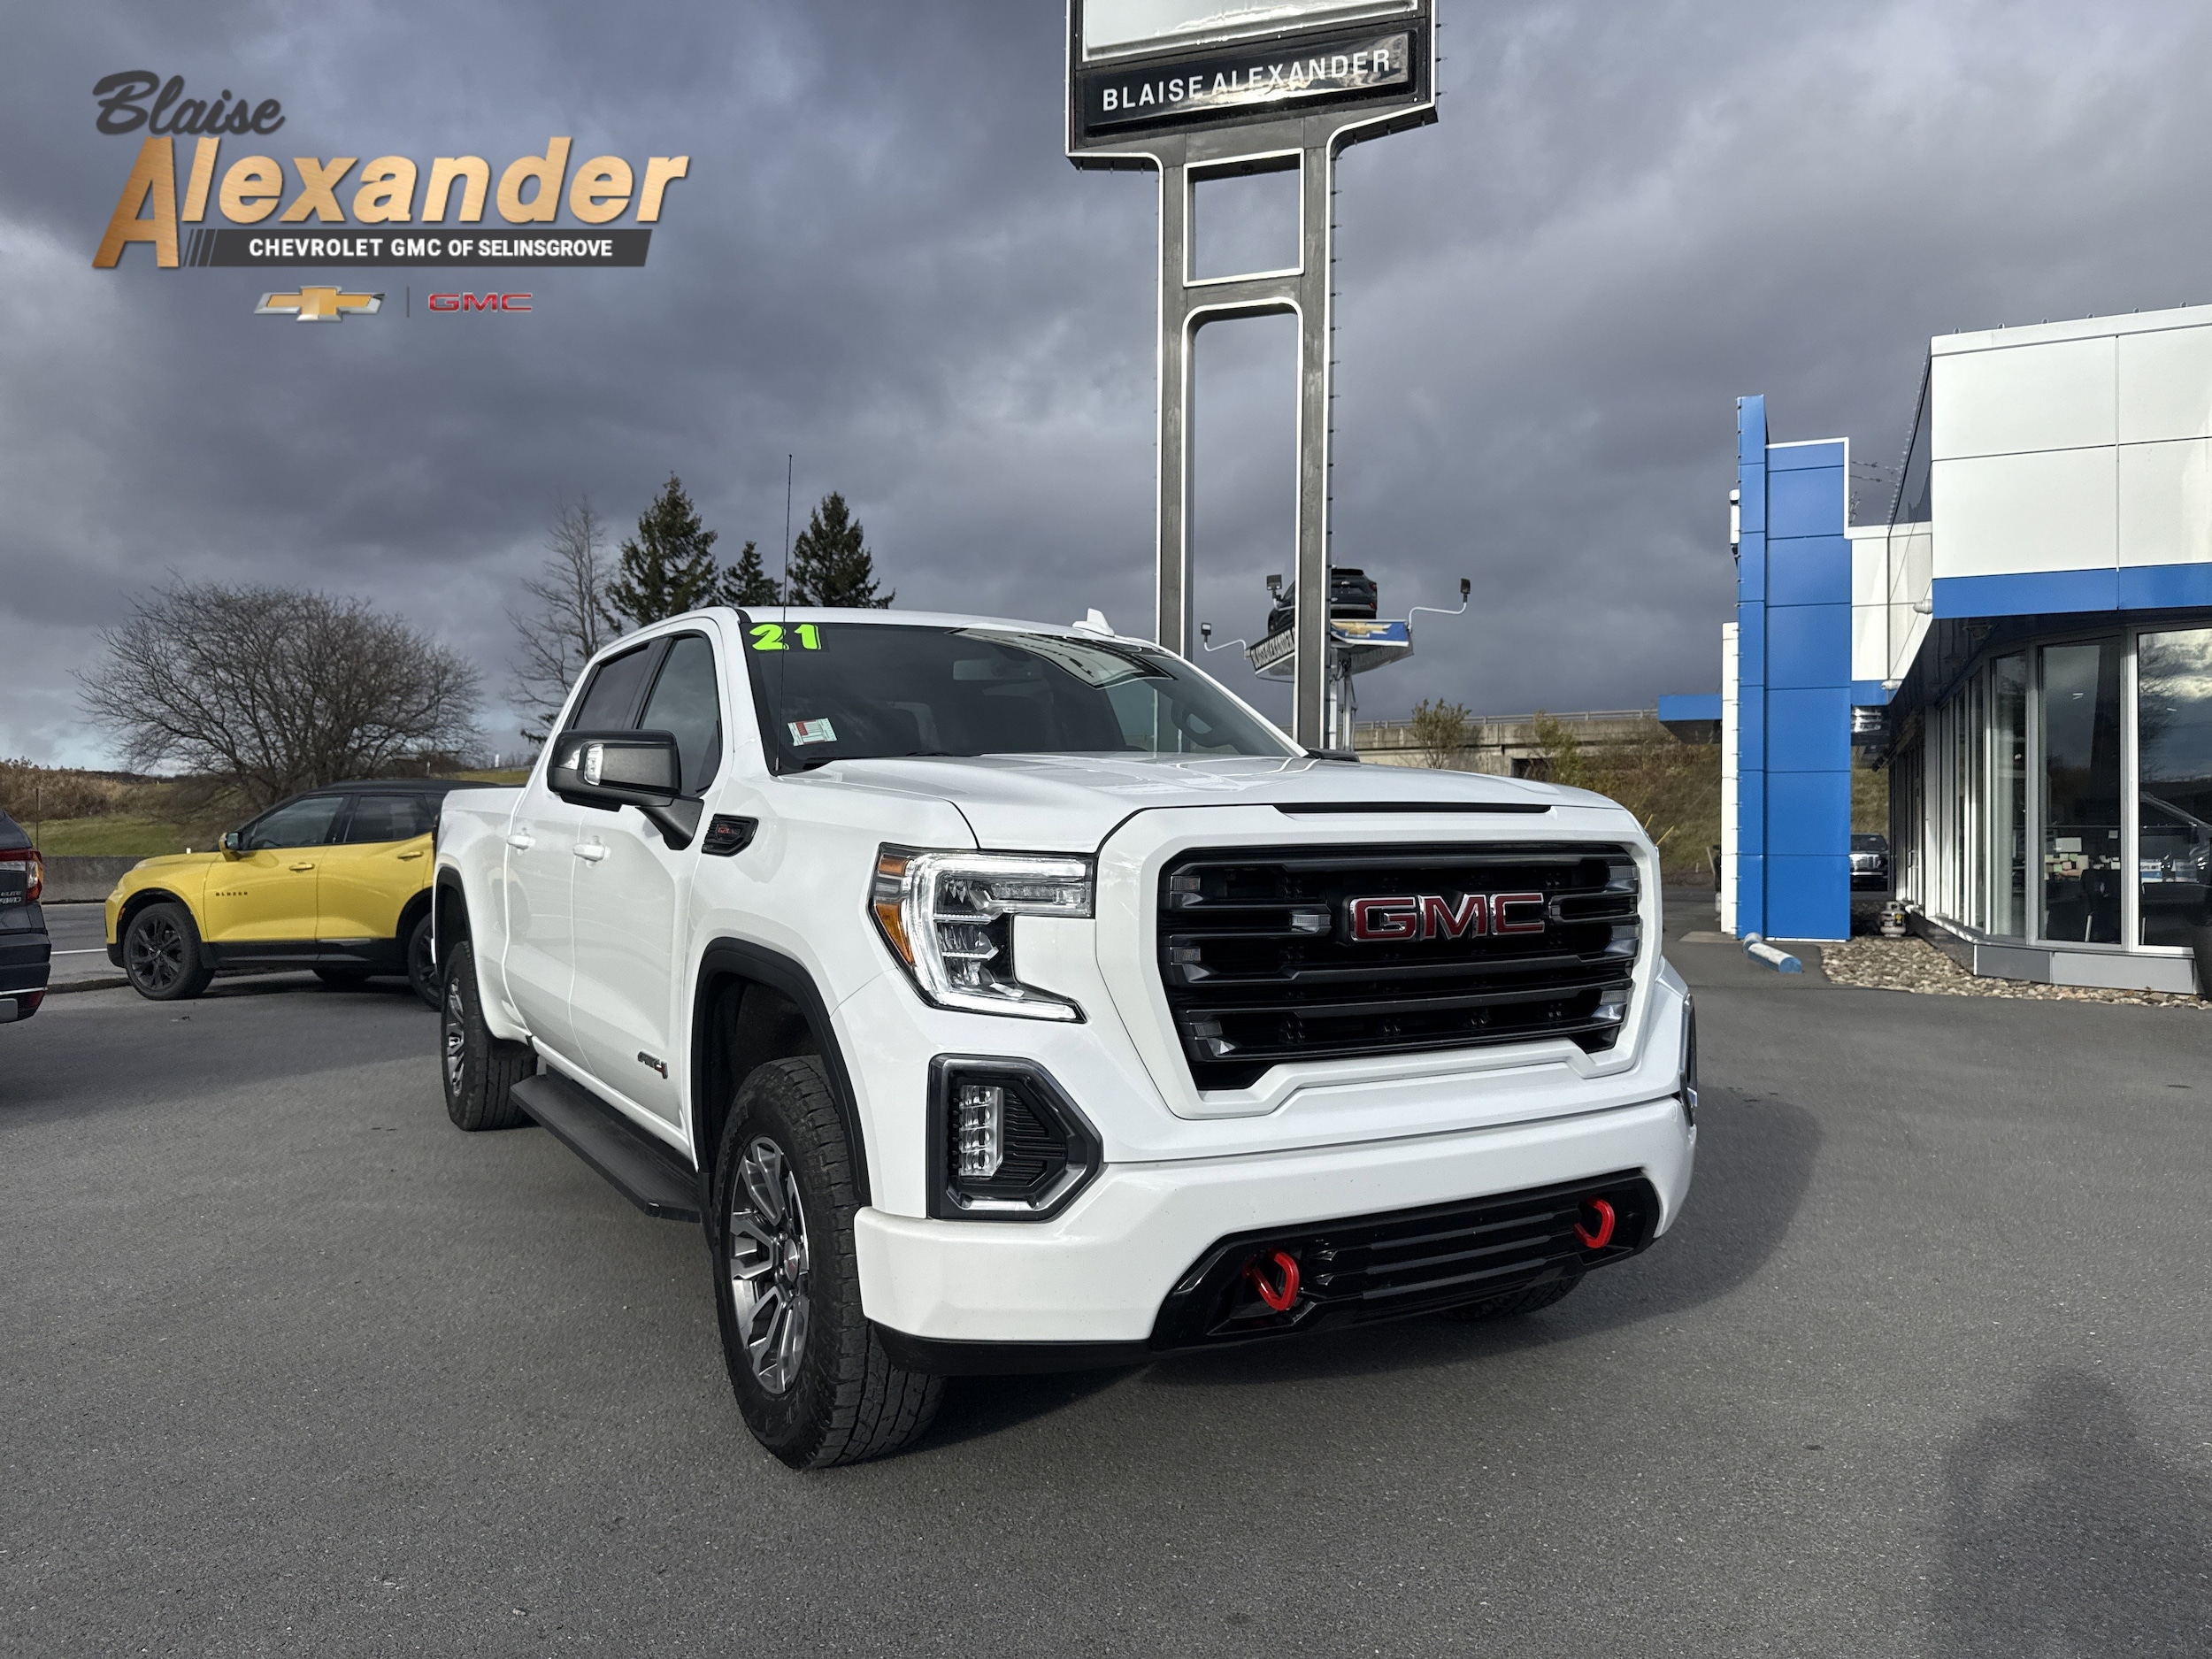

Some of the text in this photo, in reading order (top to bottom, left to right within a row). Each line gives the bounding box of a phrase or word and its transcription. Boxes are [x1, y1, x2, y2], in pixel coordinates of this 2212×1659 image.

[1102, 49, 1391, 111] BLAISE ALEXANDER
[749, 623, 822, 651] 21
[1348, 892, 1545, 942] GMC
